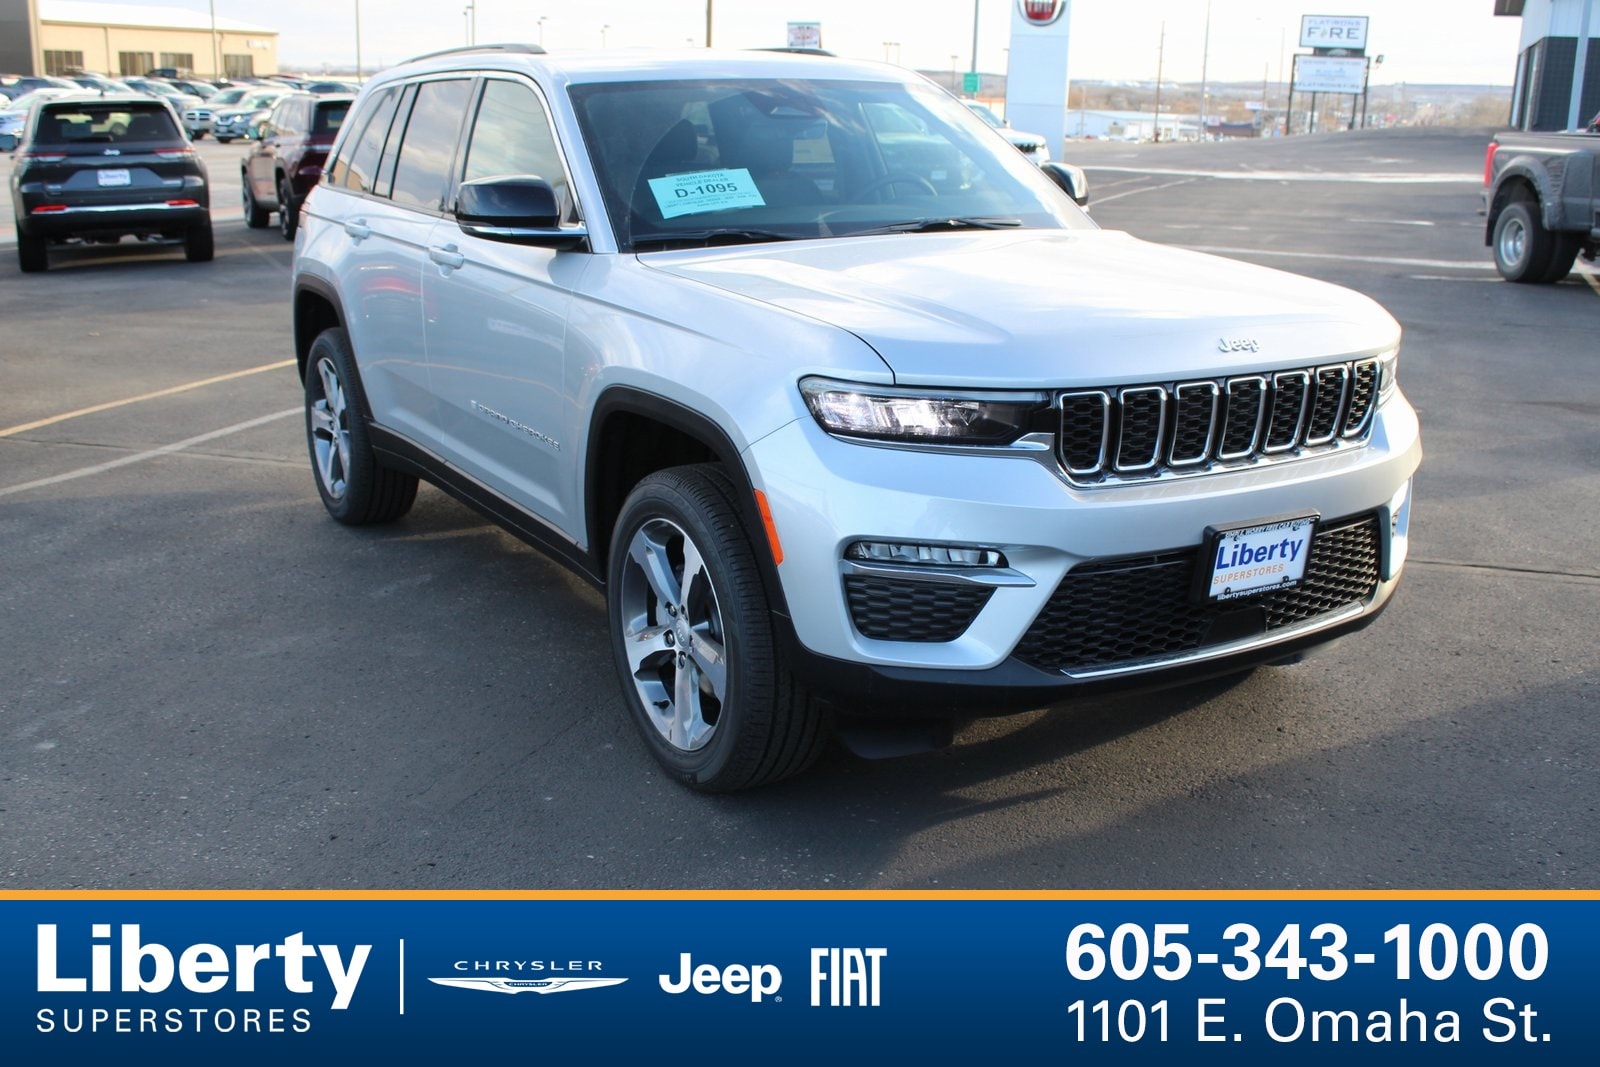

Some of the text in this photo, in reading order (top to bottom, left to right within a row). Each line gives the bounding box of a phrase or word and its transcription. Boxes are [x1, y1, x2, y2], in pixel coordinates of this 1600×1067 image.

[674, 182, 738, 198] D-1095
[1217, 337, 1261, 353] Jeep
[1216, 538, 1303, 570] Liberty
[1213, 563, 1284, 585] SUPERSTORES
[1217, 580, 1297, 601] libertysuperstores.com
